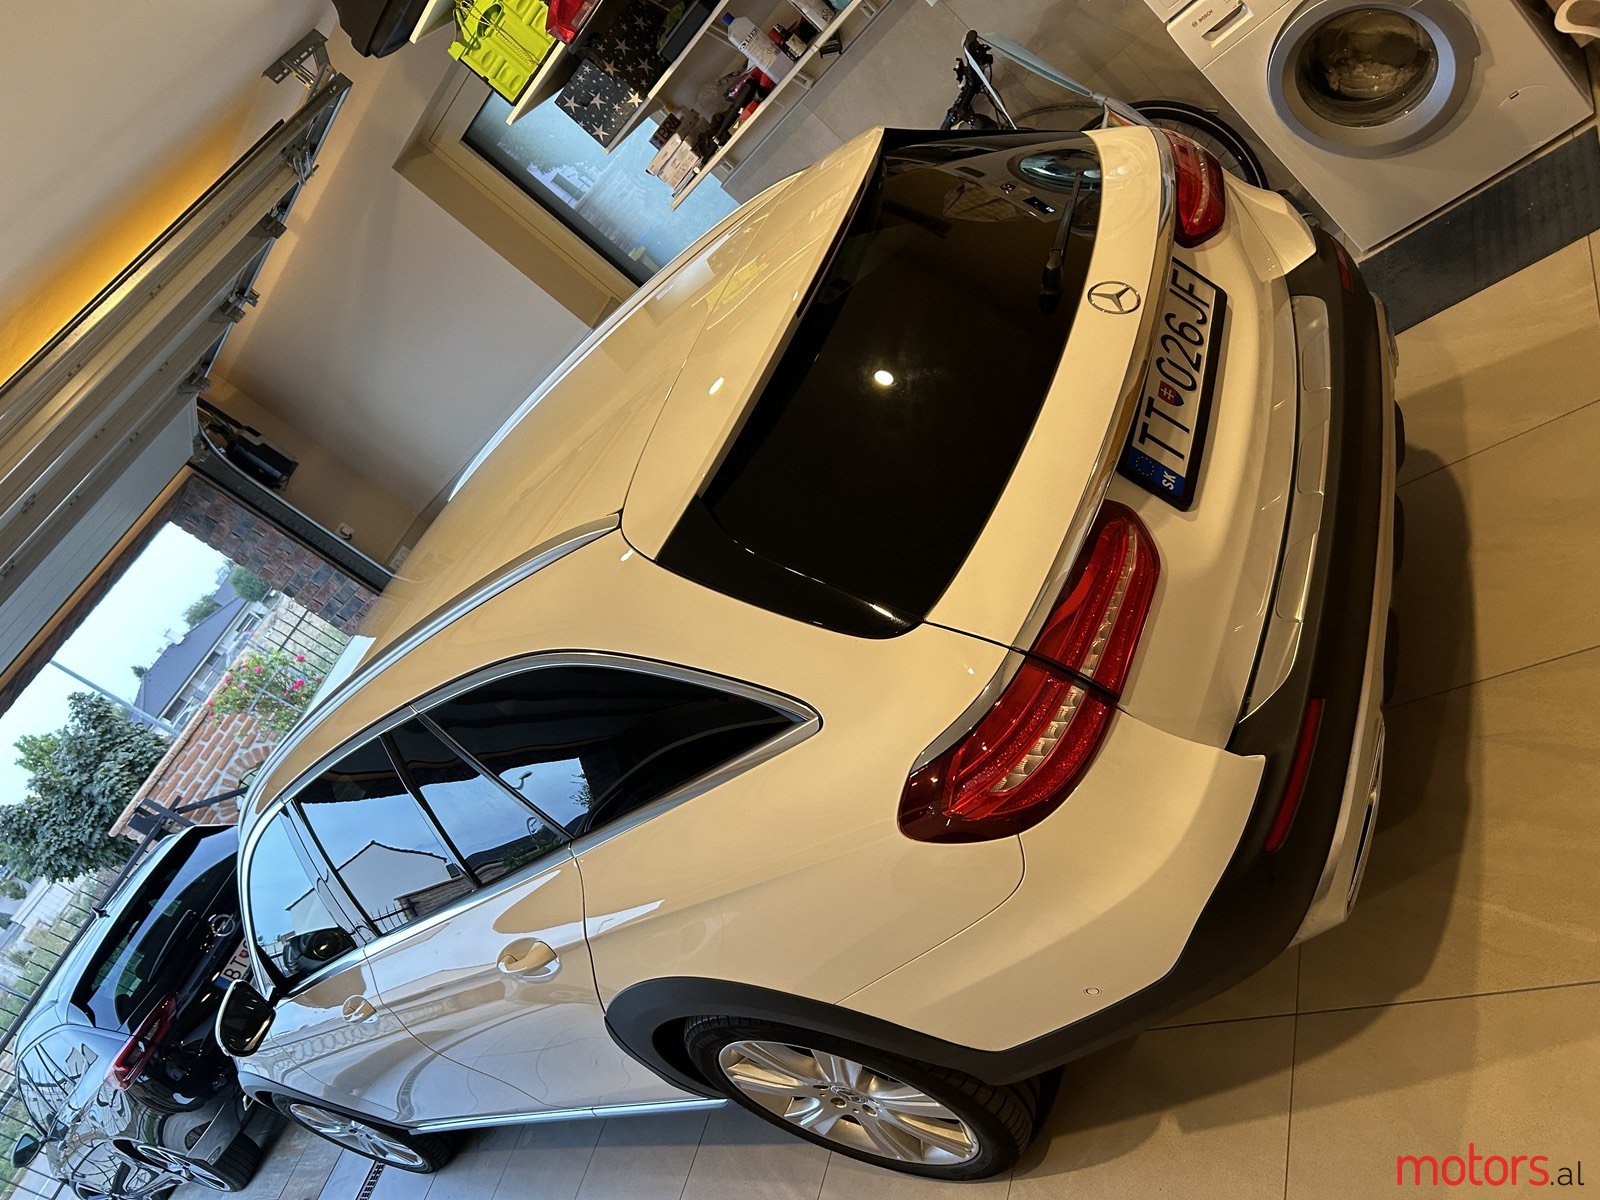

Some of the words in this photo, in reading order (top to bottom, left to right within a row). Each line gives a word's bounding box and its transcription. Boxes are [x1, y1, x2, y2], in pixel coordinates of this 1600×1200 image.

[1198, 9, 1214, 23] BOSCH
[1155, 267, 1210, 392] 026JF
[1138, 395, 1190, 461] TT
[1162, 470, 1176, 490] SK
[223, 955, 248, 981] BT
